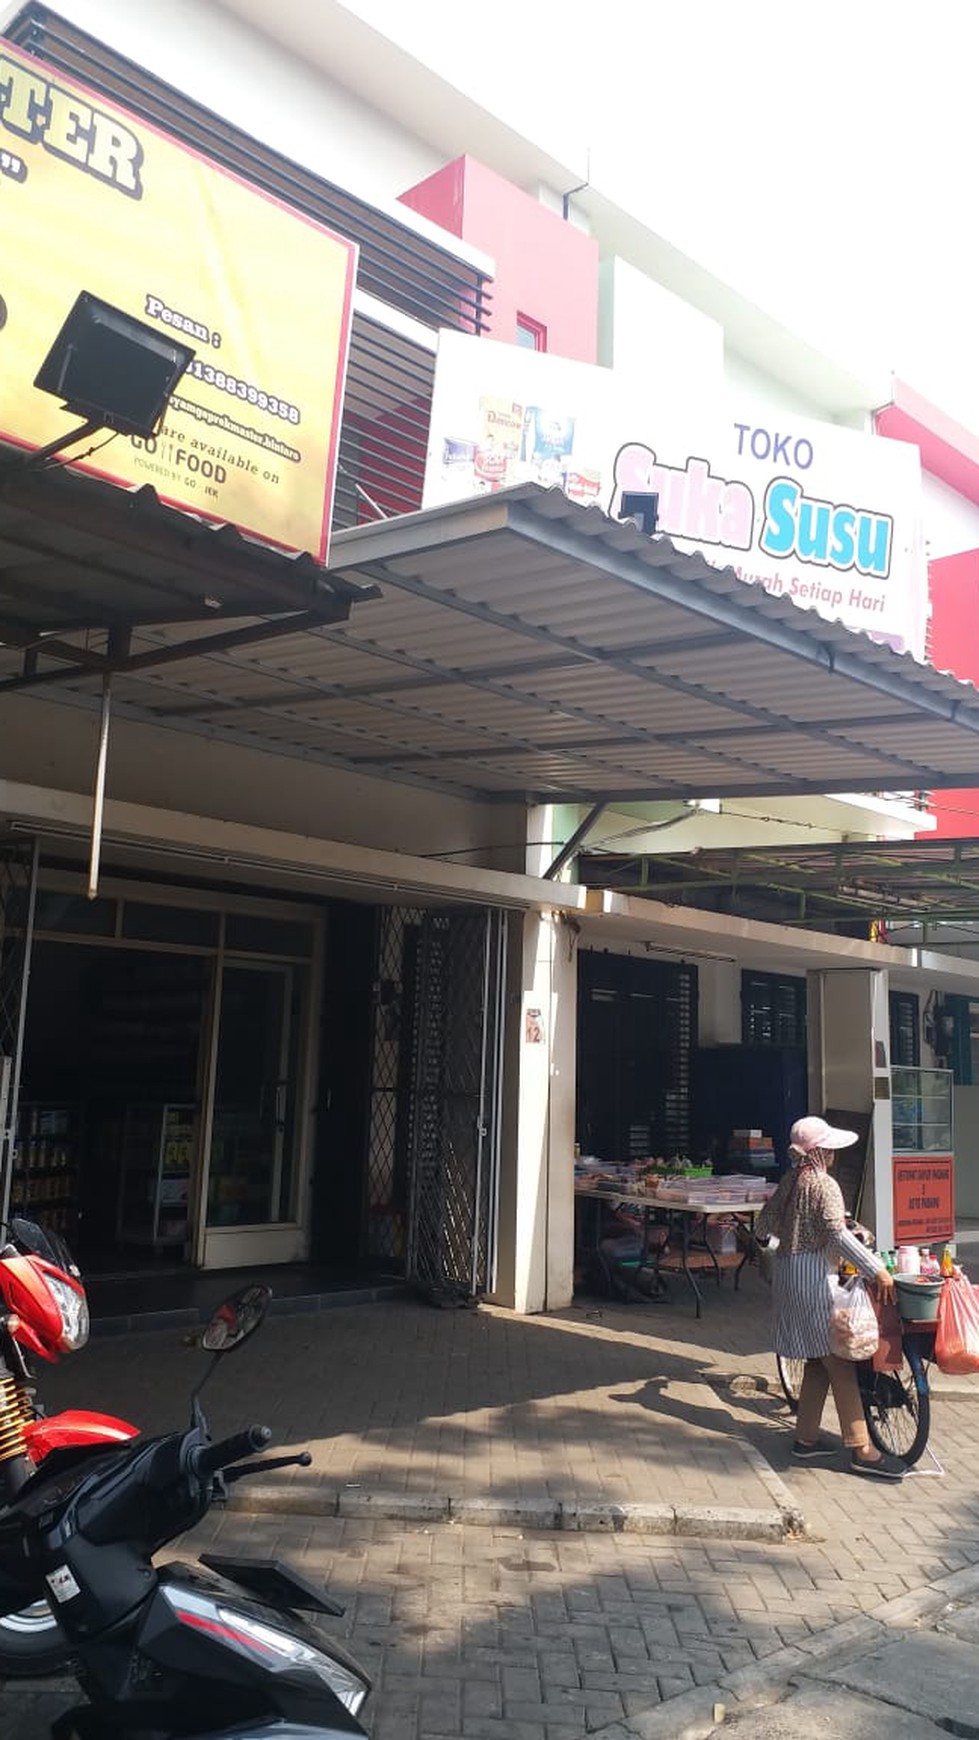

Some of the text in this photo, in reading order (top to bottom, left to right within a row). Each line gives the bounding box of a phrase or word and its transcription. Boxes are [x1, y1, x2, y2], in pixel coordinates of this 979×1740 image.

[145, 294, 210, 344] Pesan
[176, 448, 227, 484] FOOD
[190, 437, 259, 474] available
[263, 473, 280, 484] on
[734, 423, 813, 469] TOKO
[611, 444, 892, 577] Suka Susu
[789, 576, 843, 608] Setiap
[849, 588, 886, 613] Hari
